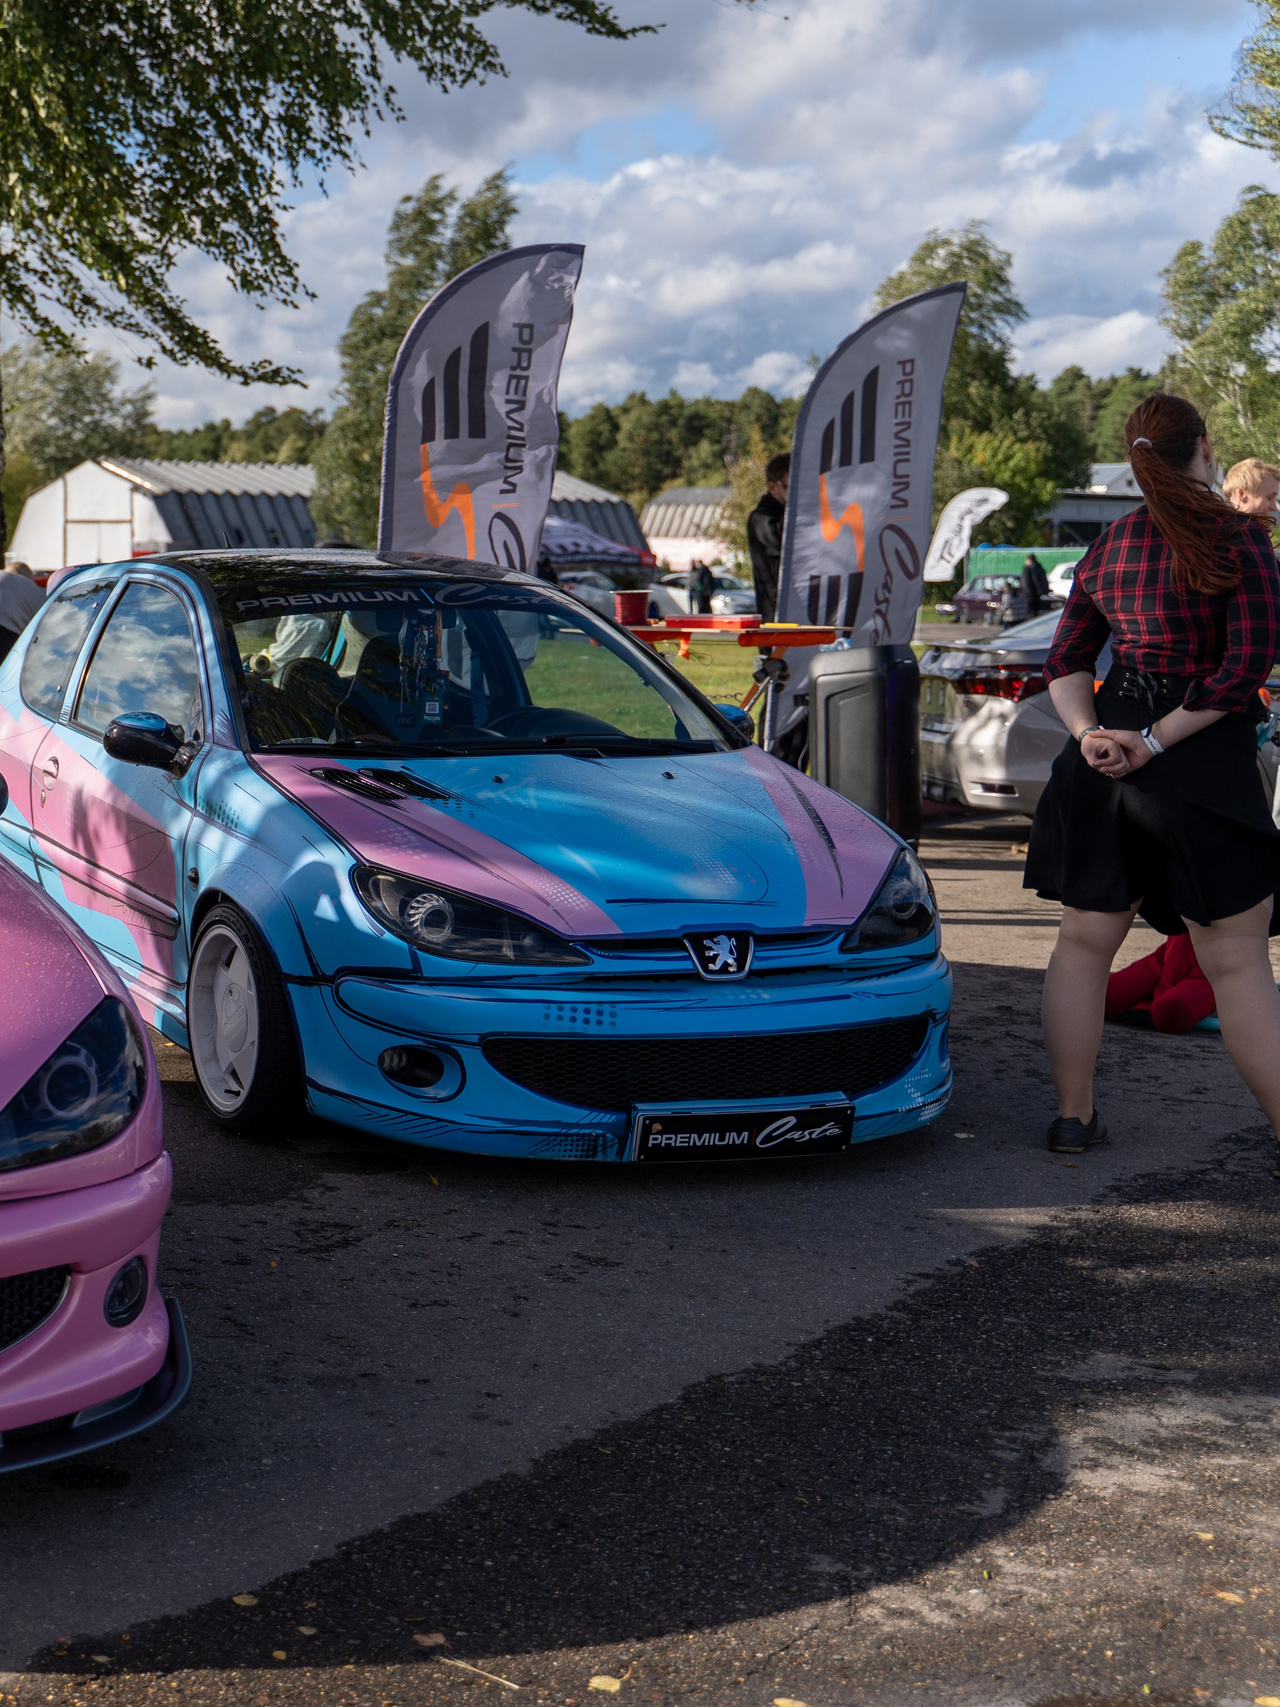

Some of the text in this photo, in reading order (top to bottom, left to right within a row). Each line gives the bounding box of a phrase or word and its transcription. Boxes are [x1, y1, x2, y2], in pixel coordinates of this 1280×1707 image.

[498, 322, 535, 495] PREMIUM
[889, 358, 915, 510] PREMIUM
[235, 588, 420, 613] PREMIUM
[648, 1115, 843, 1149] PREMIUM Caste
